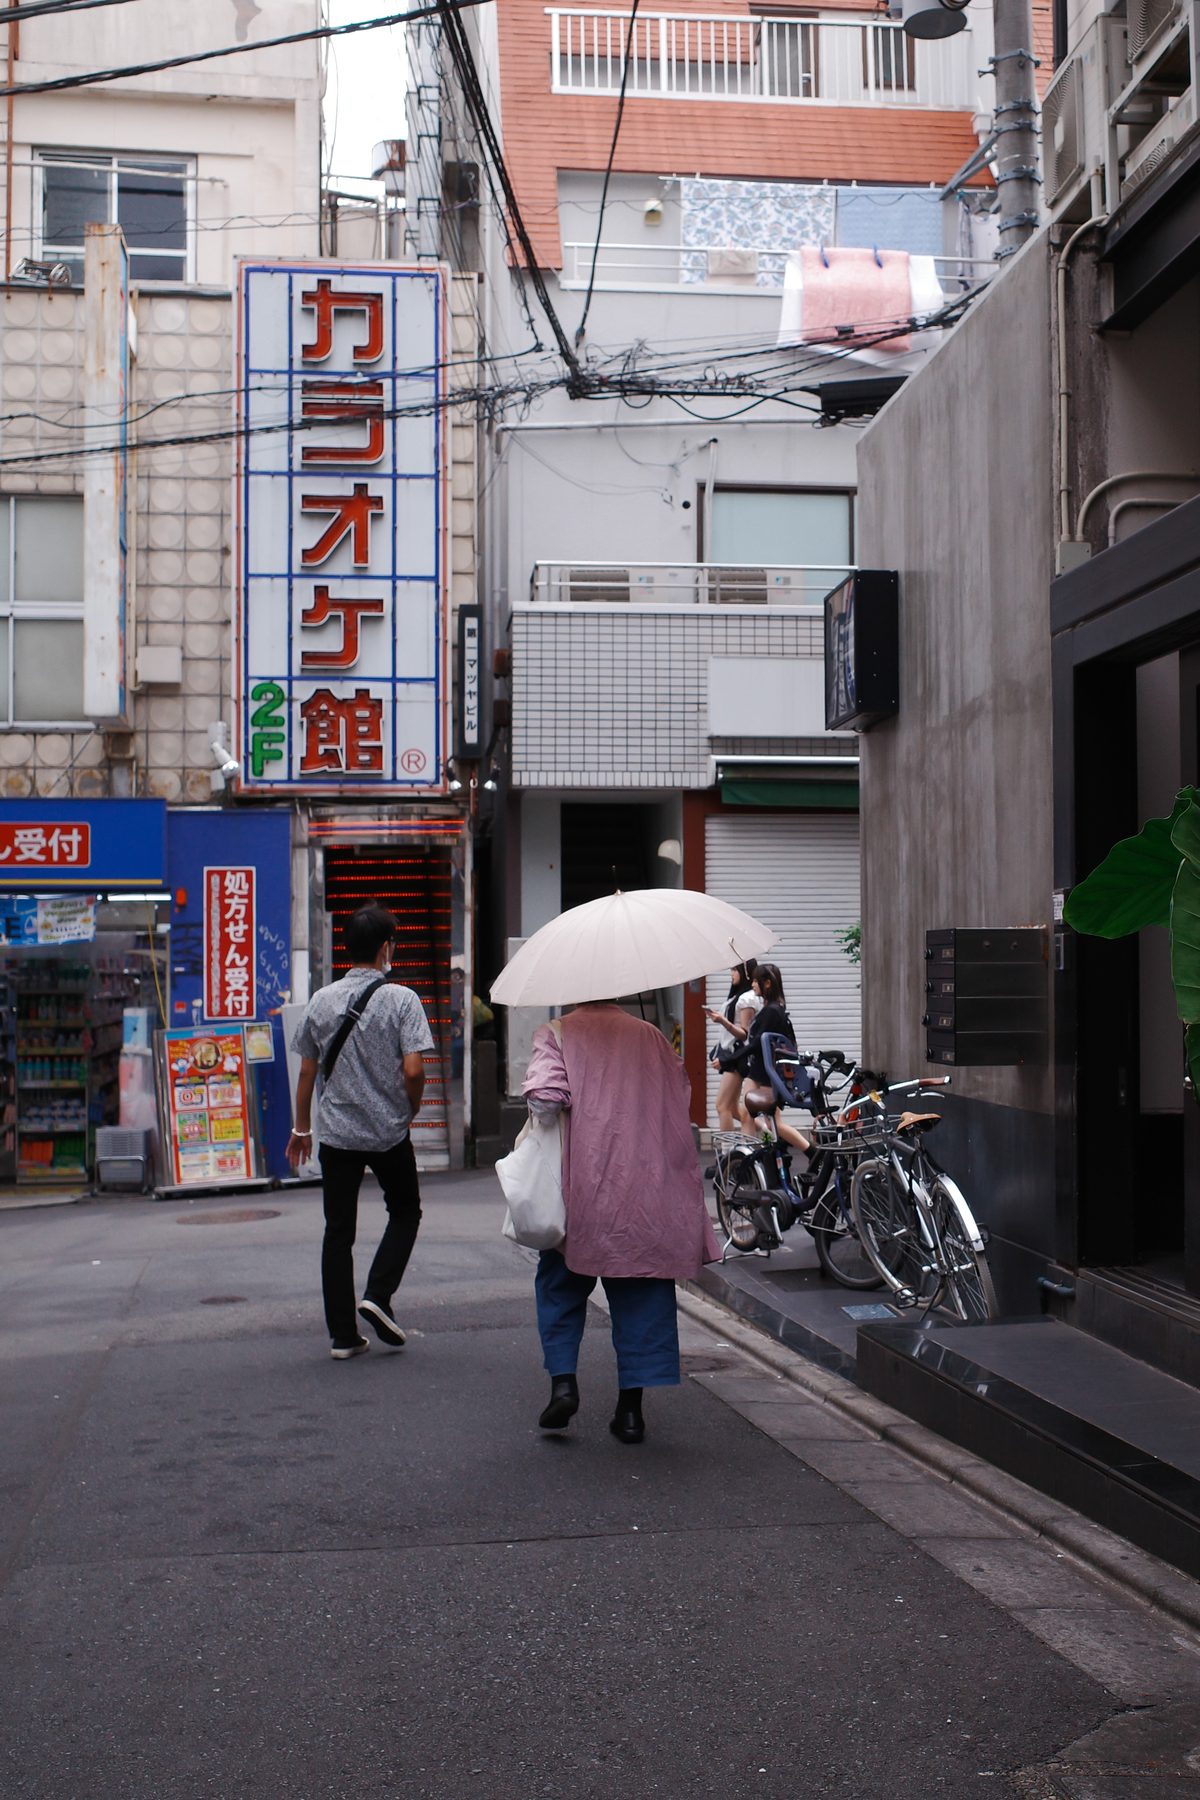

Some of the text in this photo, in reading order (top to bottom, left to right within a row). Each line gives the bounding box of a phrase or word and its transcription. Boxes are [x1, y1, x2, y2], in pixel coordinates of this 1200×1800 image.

[299, 278, 384, 775] カラオケ館
[251, 682, 285, 777] 2F
[224, 871, 249, 1016] 処方せん受付
